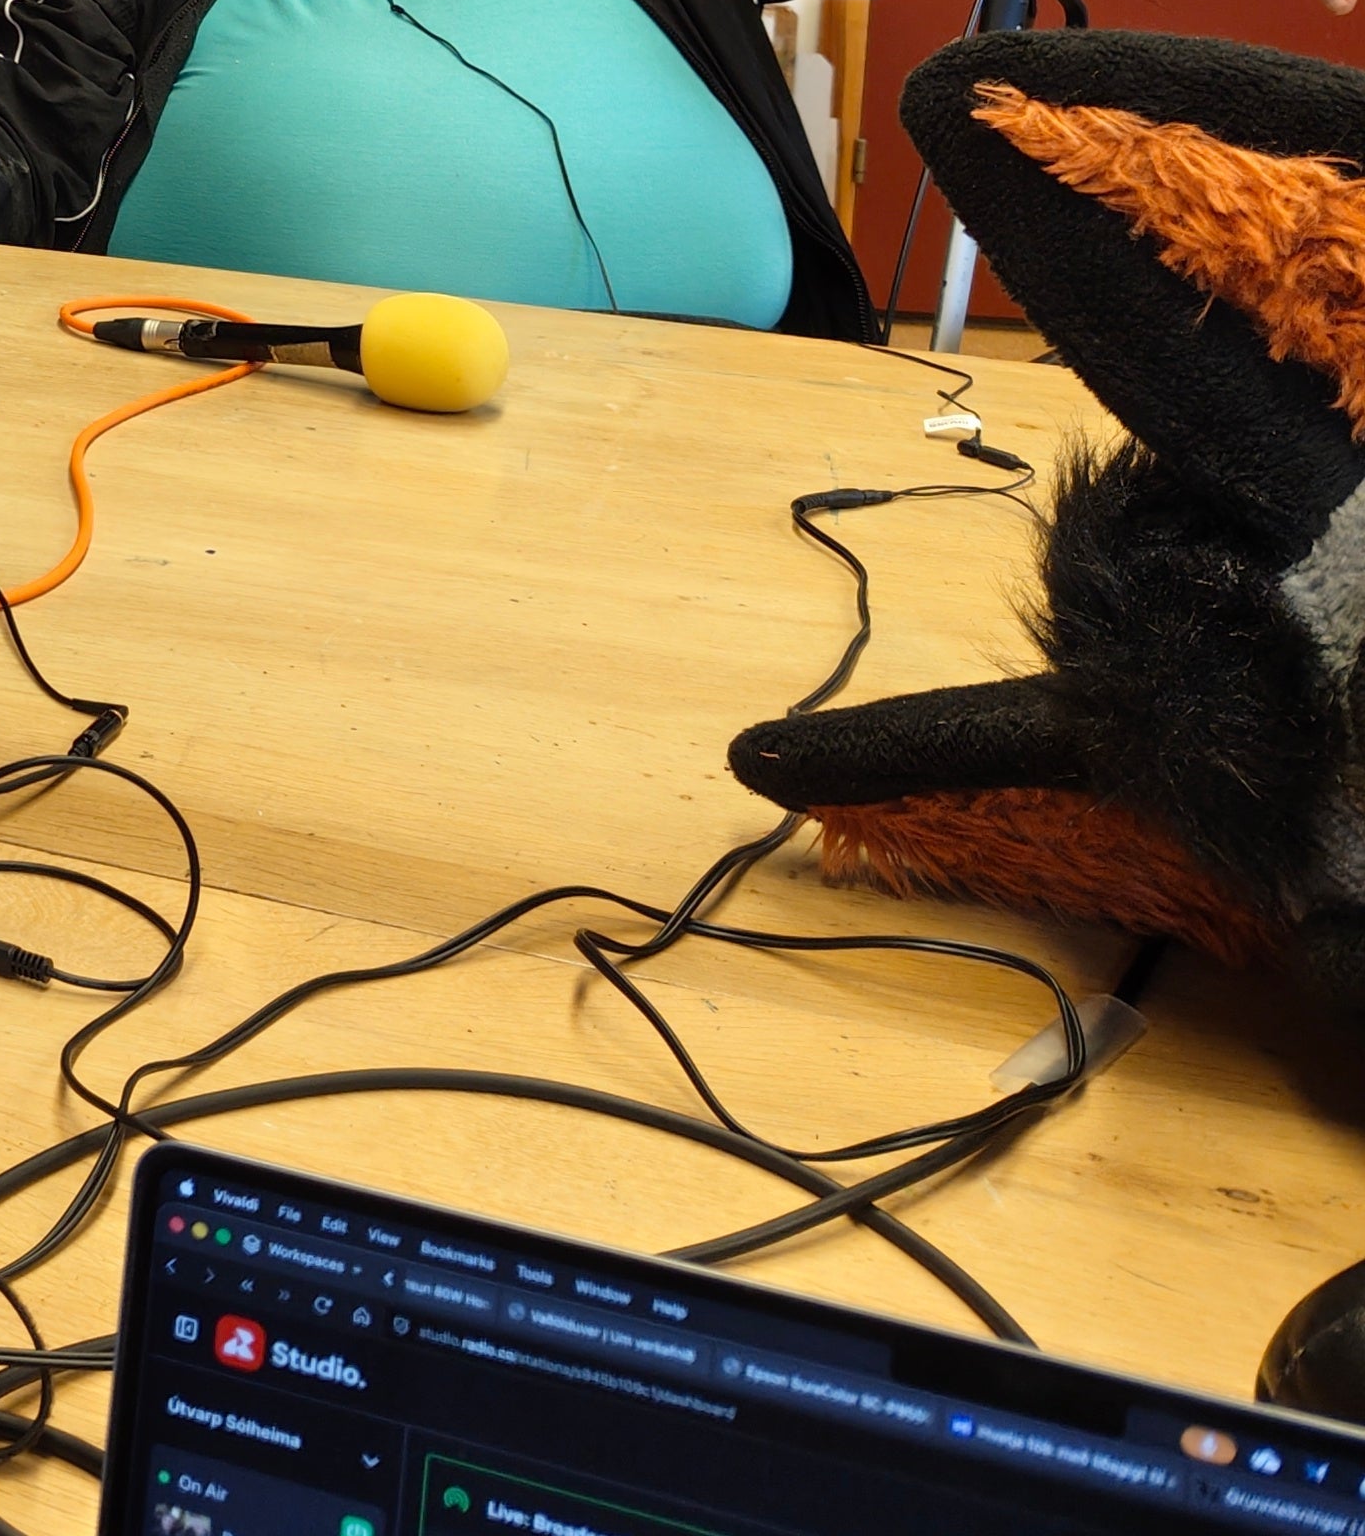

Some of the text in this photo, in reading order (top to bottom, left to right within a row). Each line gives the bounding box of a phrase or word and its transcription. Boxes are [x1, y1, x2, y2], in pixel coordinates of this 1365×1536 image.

[214, 1188, 689, 1322] Vivaldi File Edit View Bookmarks Tools Window Help
[269, 1241, 346, 1275] Workspaces
[271, 1340, 368, 1390] Studio.
[167, 1394, 302, 1451] Útvarp Sólheima
[179, 1473, 229, 1502] On Air
